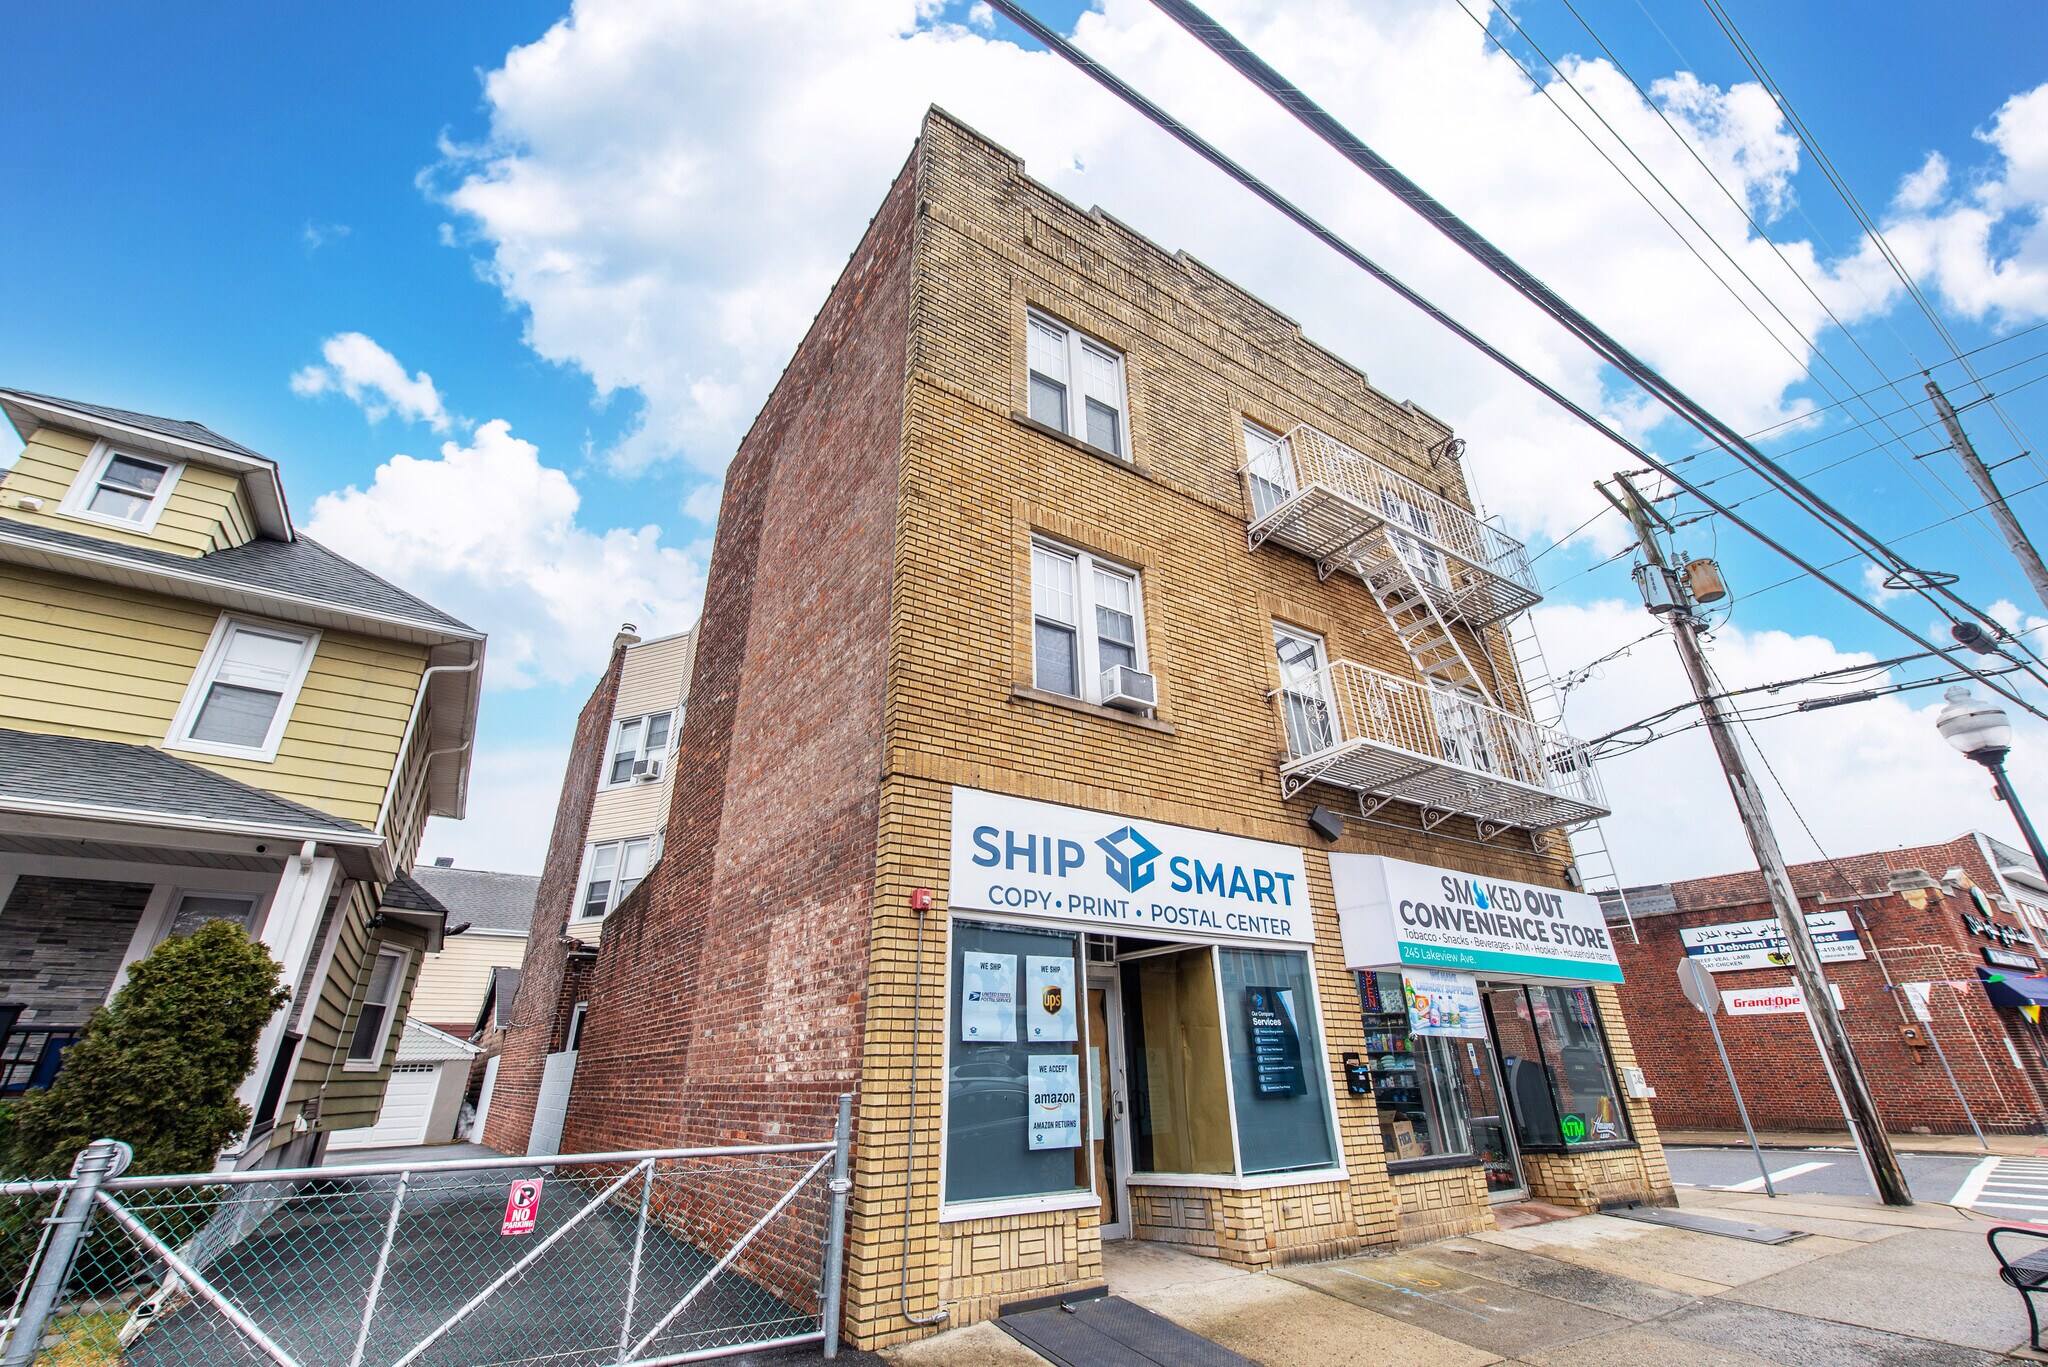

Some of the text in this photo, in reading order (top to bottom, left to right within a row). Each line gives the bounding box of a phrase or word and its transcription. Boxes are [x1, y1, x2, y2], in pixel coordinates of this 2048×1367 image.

[972, 826, 1295, 906] SHIP SMART
[988, 885, 1291, 936] COPY PRINT POSTAL CENTER
[1524, 889, 1564, 919] OUT
[1399, 900, 1609, 949] CONVENIENCE STORE
[1403, 928, 1437, 942] Tobacco
[1442, 933, 1469, 946] Snacks
[1474, 937, 1511, 951] Beverages
[1515, 942, 1530, 952] ATM
[1534, 944, 1560, 955] Hookah
[1563, 948, 1595, 959] Household
[1703, 944, 1715, 954] Al
[1403, 946, 1477, 964] 245 Lakeview Ave.
[980, 962, 1002, 971] WE SHIP
[1044, 994, 1061, 1011] ups
[1734, 997, 1772, 1007] Grand
[1252, 1017, 1282, 1026] Services
[1039, 1065, 1068, 1073] WE ACCEPT
[1034, 1092, 1075, 1104] amazon
[1033, 1120, 1077, 1129] AMAZON RETURNS
[1562, 1121, 1585, 1137] ATM
[511, 1208, 531, 1221] NO
[503, 1220, 534, 1229] PARKING
